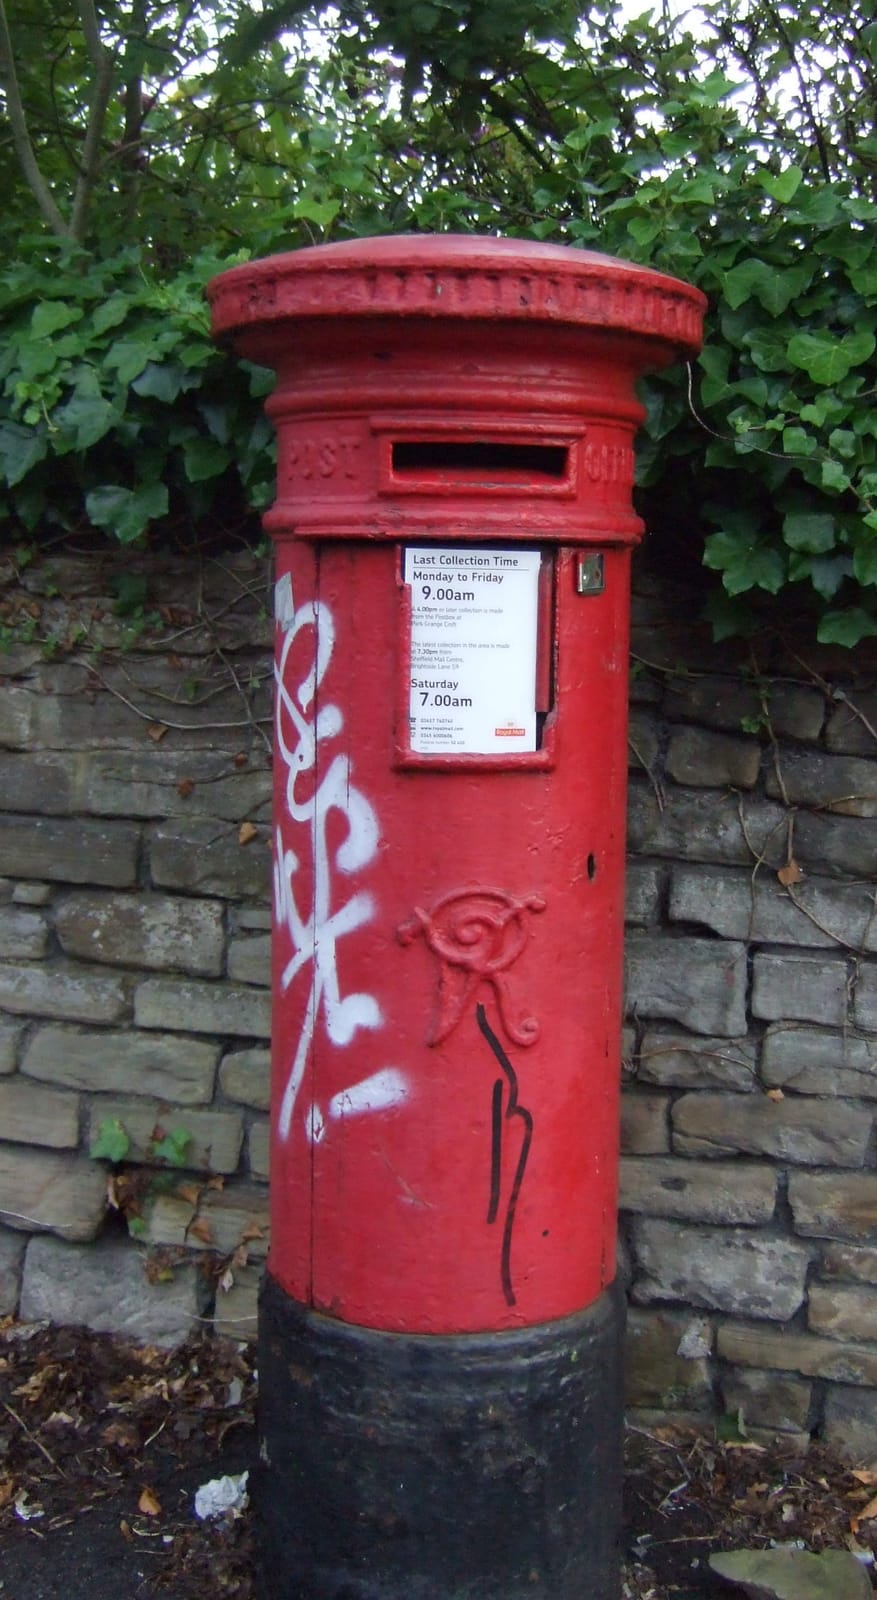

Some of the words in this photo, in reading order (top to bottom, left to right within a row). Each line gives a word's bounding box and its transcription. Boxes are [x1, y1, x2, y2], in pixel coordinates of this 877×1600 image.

[413, 555, 435, 565] Last
[439, 555, 489, 566] Collection
[493, 557, 518, 566] Time
[413, 571, 454, 583] Monday
[458, 573, 468, 582] to
[472, 573, 504, 584] Friday
[422, 586, 475, 601] 9.00am
[411, 679, 459, 691] Saturday
[420, 692, 472, 707] 7.00am
